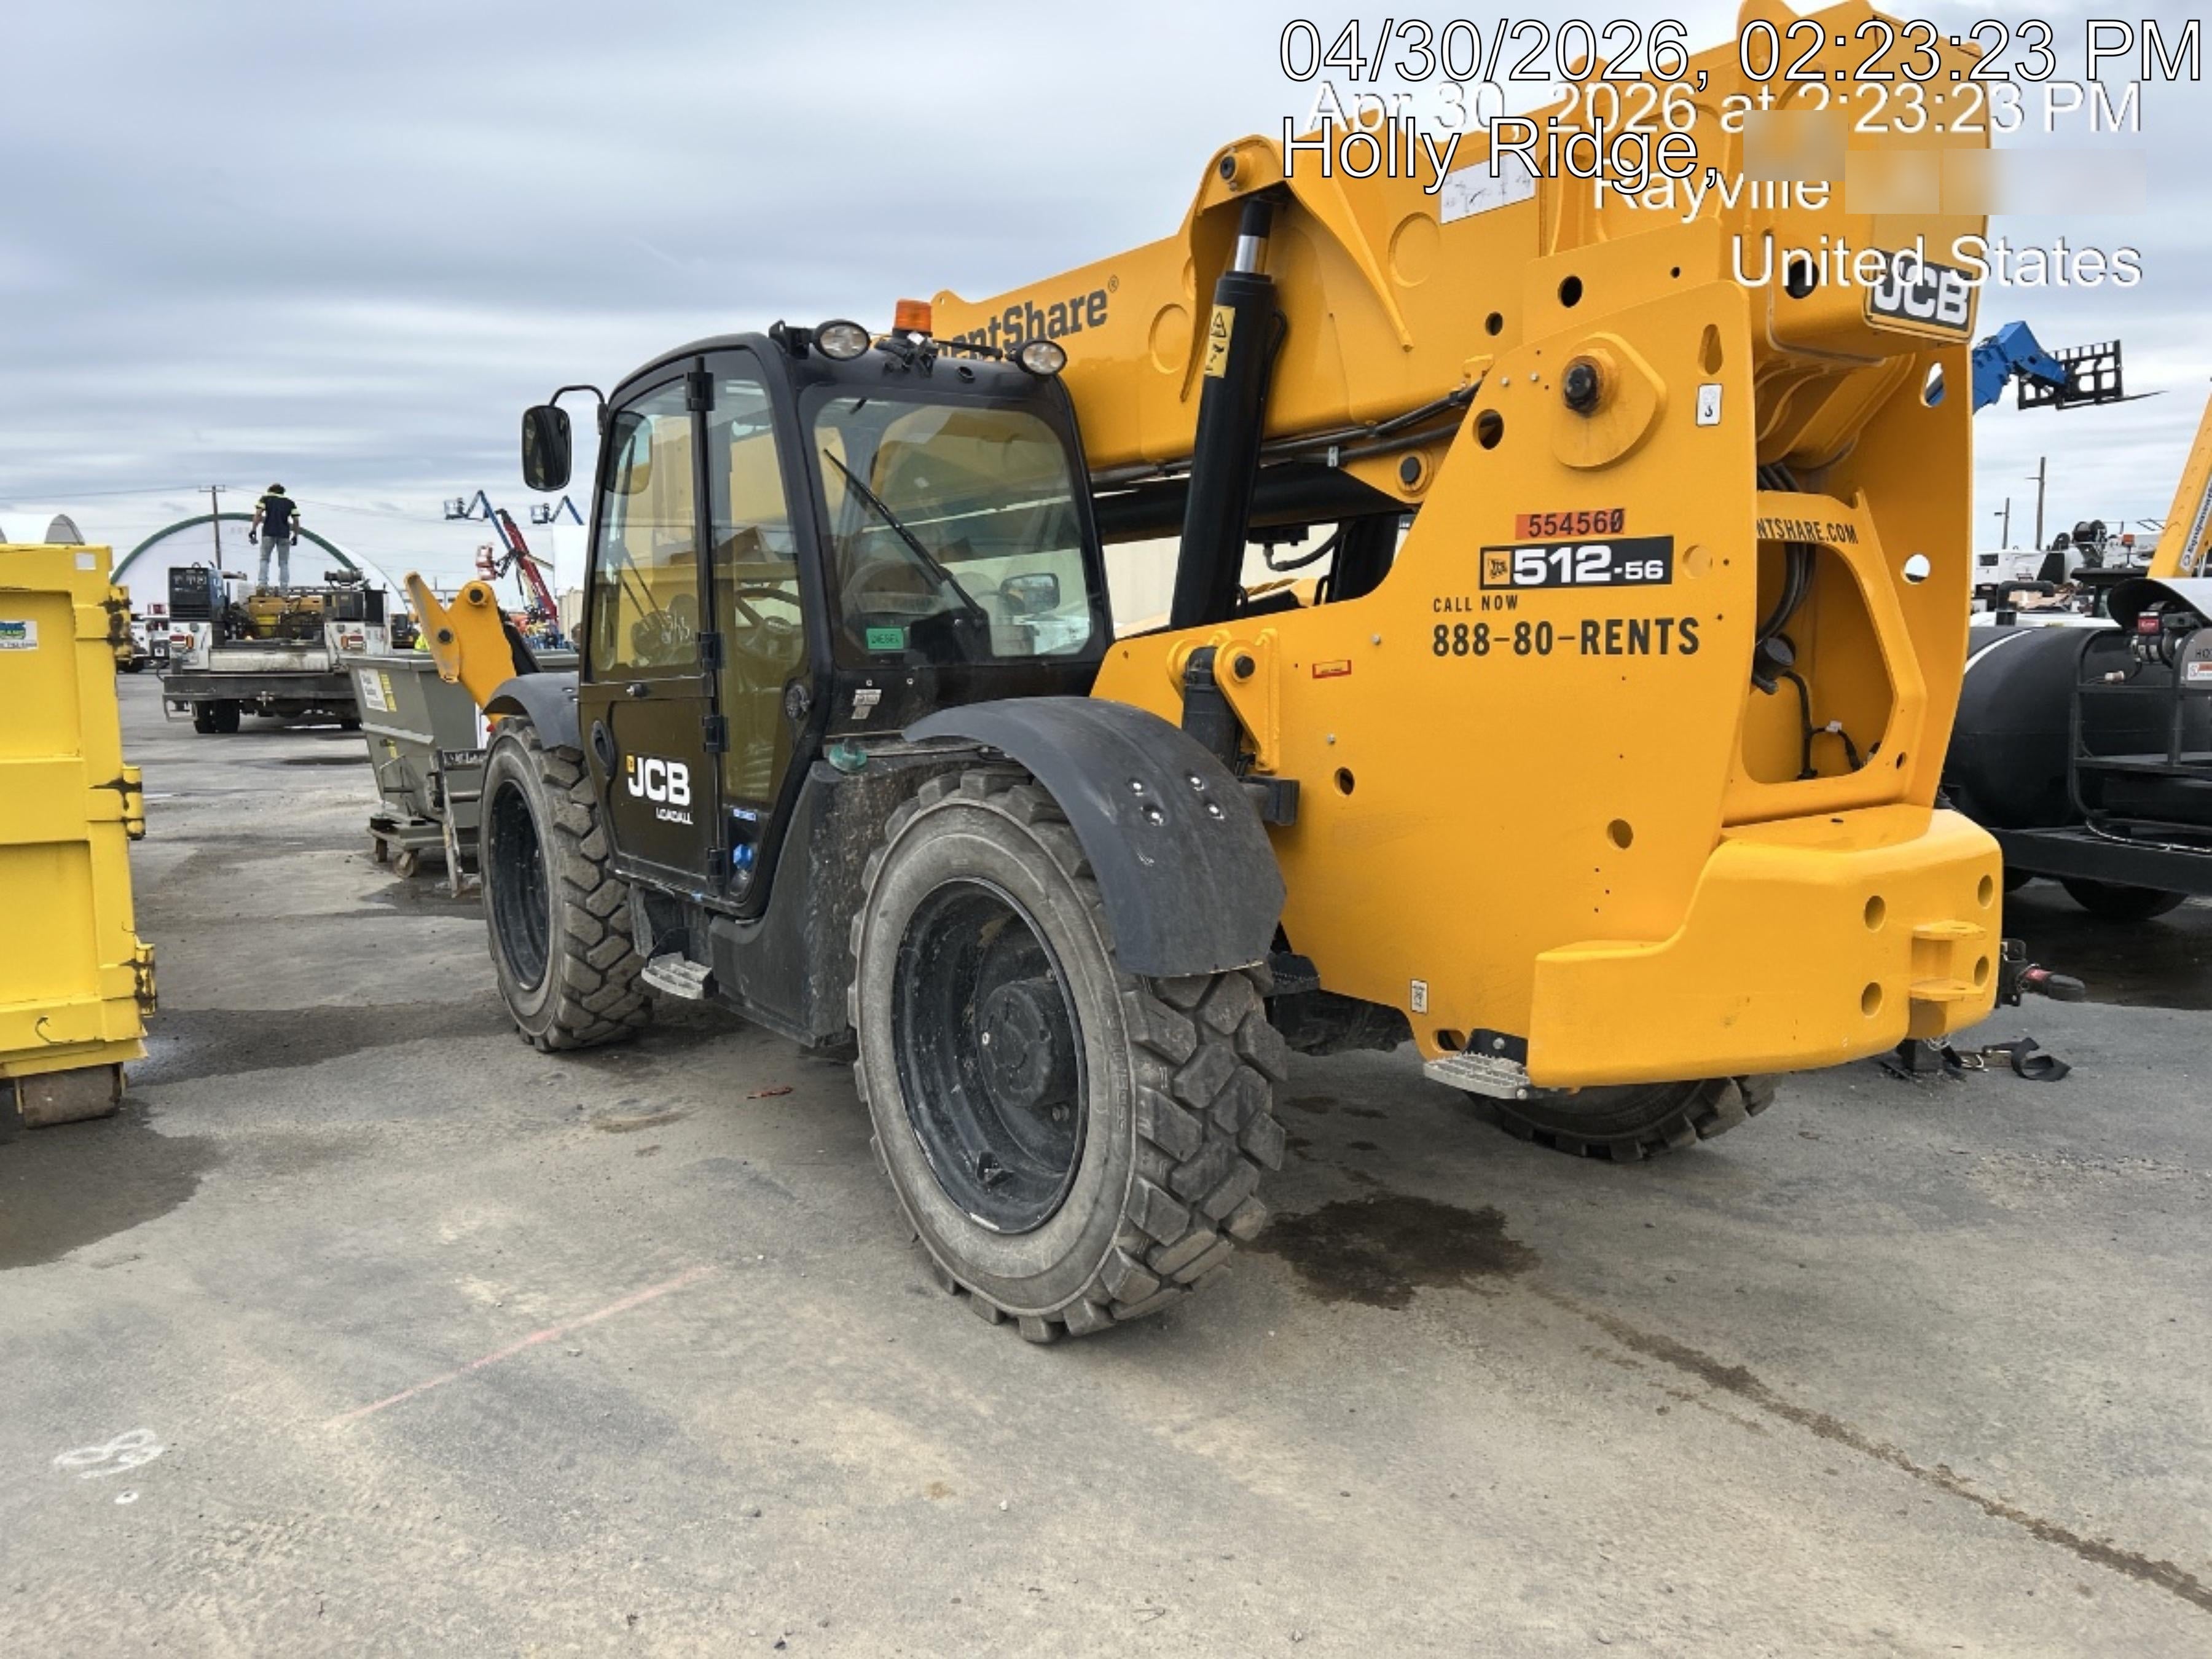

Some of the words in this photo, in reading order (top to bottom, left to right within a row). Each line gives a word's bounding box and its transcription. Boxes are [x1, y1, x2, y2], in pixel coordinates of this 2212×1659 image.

[1874, 261, 1969, 324] JCB
[1528, 508, 1625, 538] 554560
[1513, 544, 1664, 585] 512-56
[1433, 596, 1473, 613] CALL
[1481, 595, 1518, 611] NOW
[1432, 617, 1700, 657] 888-80-RENTS
[627, 756, 691, 806] JCB
